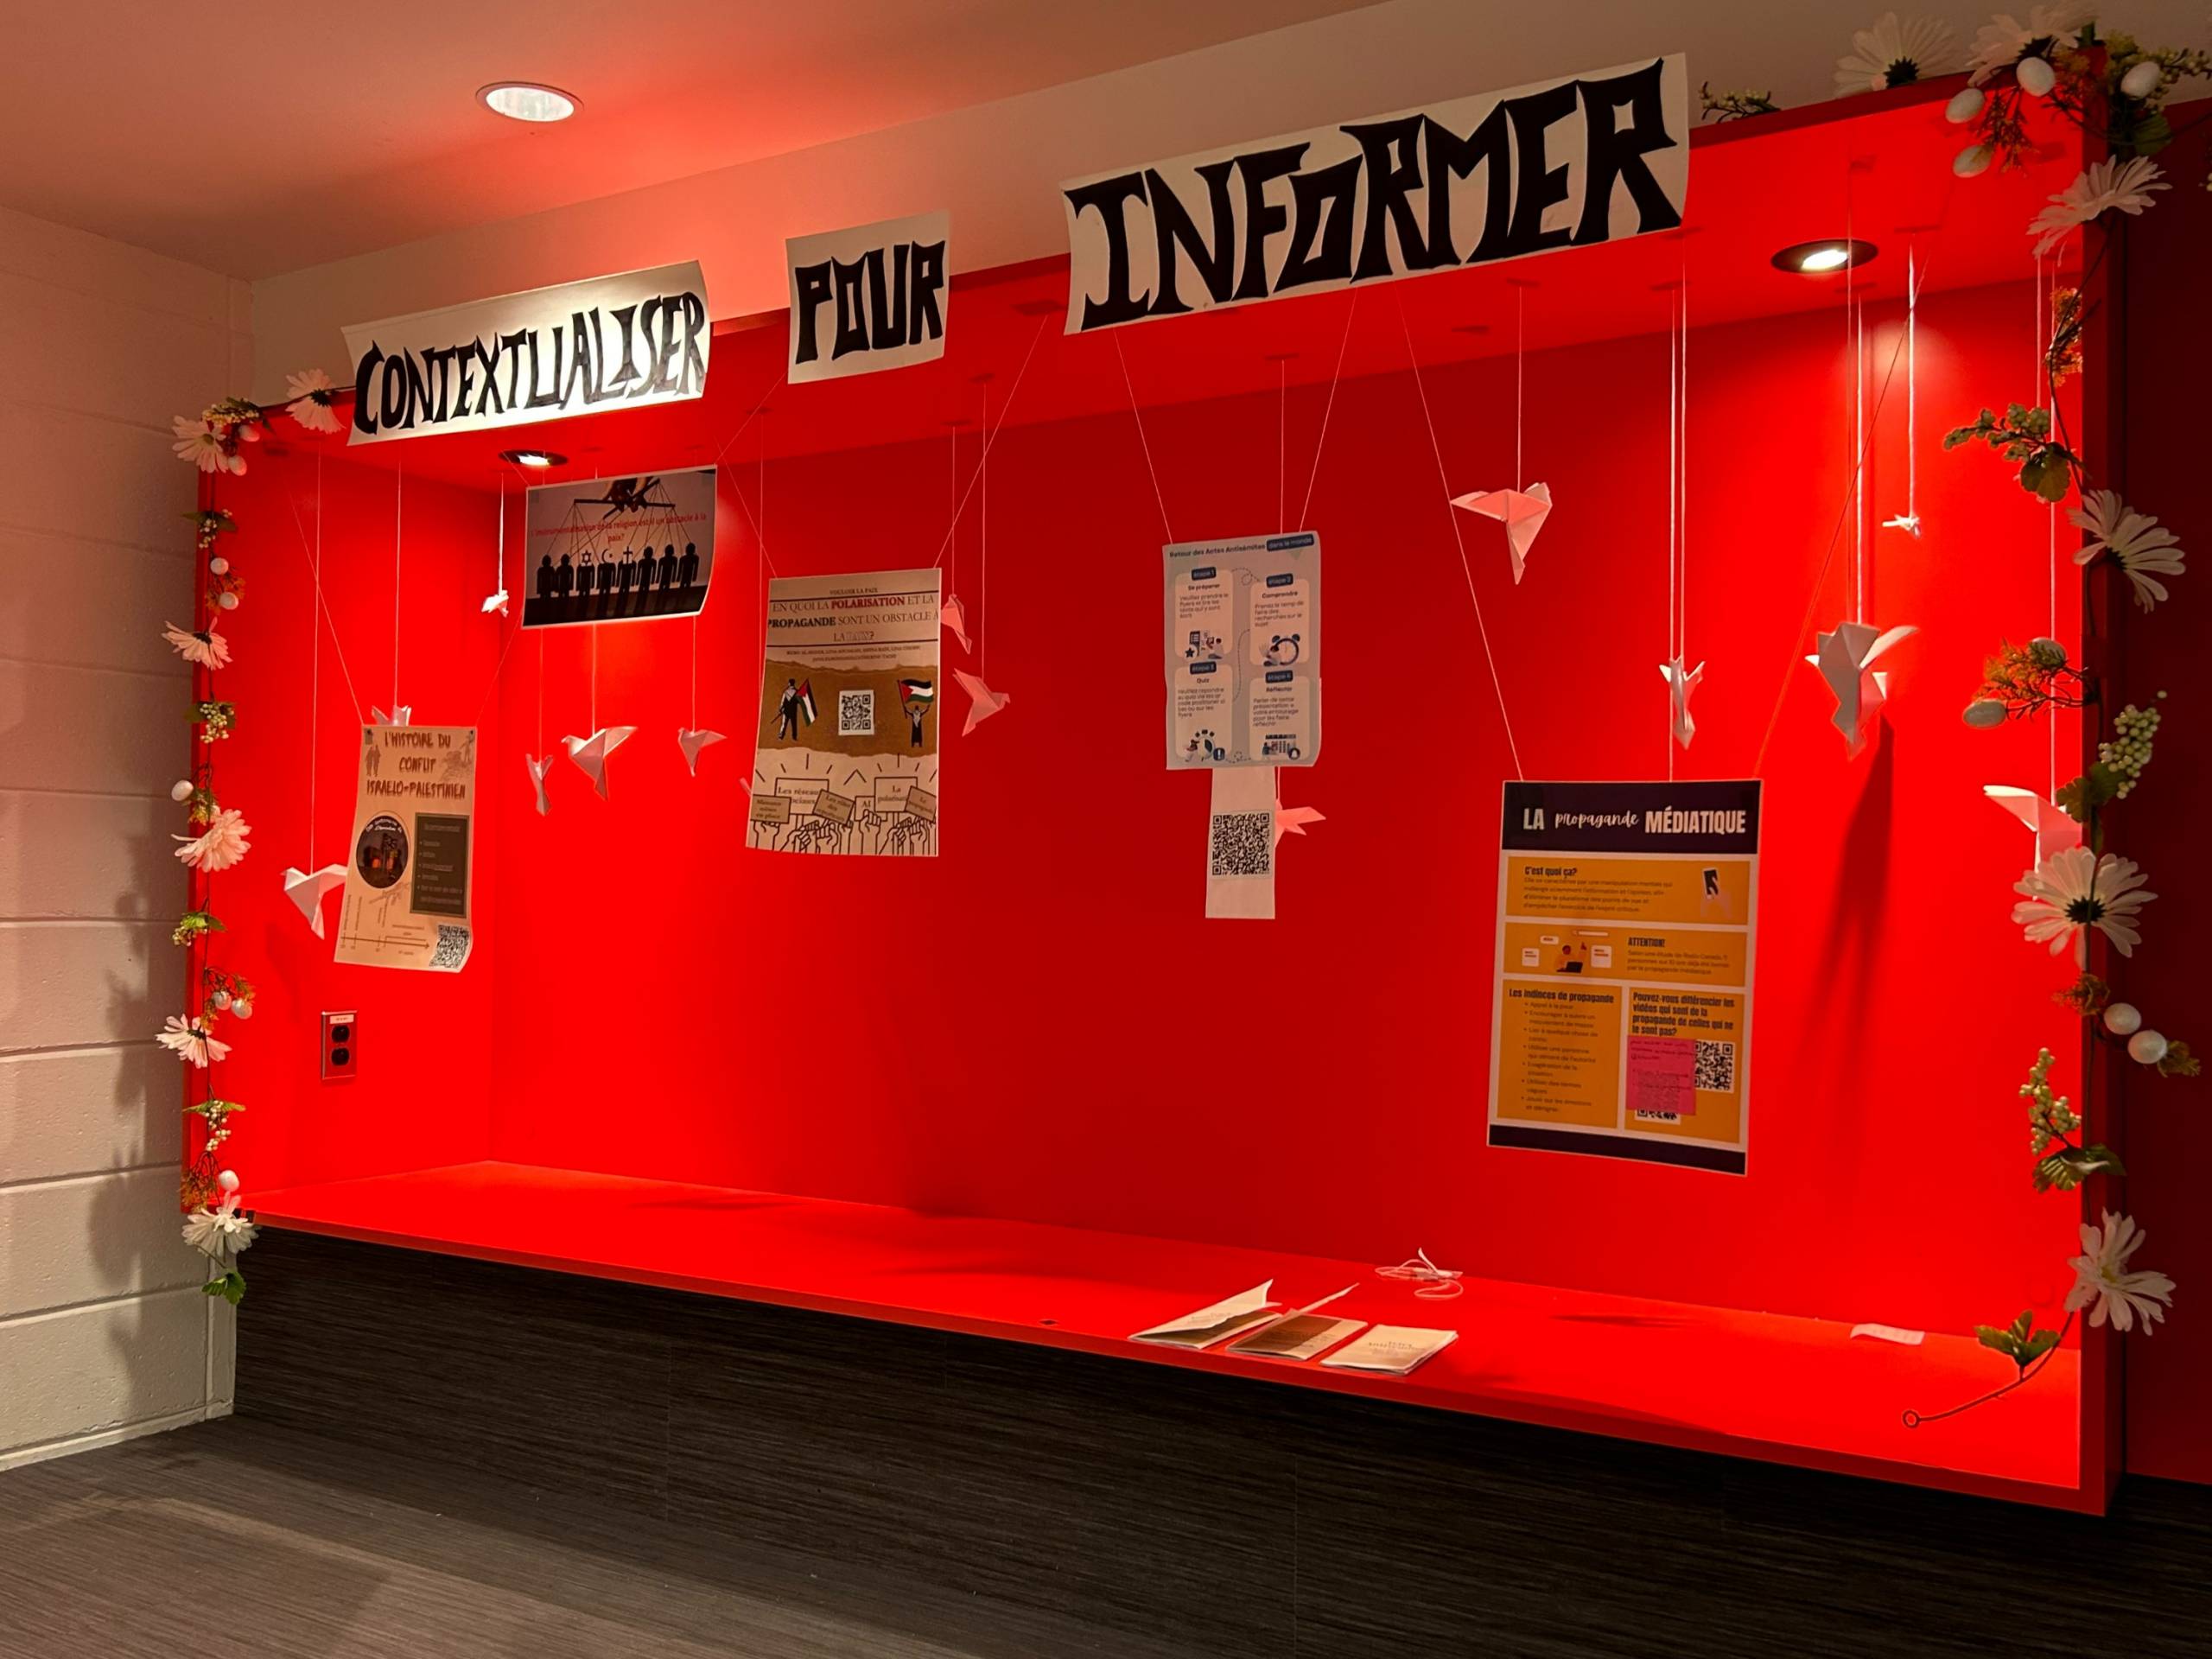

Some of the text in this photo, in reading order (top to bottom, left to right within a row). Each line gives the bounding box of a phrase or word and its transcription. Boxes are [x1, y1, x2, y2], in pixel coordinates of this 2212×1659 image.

[1075, 57, 1682, 314] INFORMER
[794, 239, 946, 364] POUR
[353, 290, 709, 435] CONTEXTUALISER
[773, 594, 934, 613] EN QUOI LA POLARISATION ET LA
[768, 616, 836, 629] PROPAGANDE
[838, 614, 864, 626] SONT
[866, 613, 880, 624] UN
[883, 611, 931, 623] OBSTACLE
[834, 632, 845, 642] LA
[384, 731, 452, 749] L'HISTOIRE DU
[793, 787, 819, 796] réseau
[1522, 805, 1747, 836] LA propagande MÉDIATIQUE
[1524, 866, 1579, 880] C'est quoi ça?
[1627, 936, 1666, 948] ATTENTION!
[1509, 988, 1522, 998] Les
[1558, 991, 1568, 1001] de
[1569, 993, 1615, 1004] propagande
[1633, 991, 1679, 1004] Pouvez-vous
[1723, 997, 1735, 1008] les
[1633, 1002, 1708, 1017] vidéos qui sont de la
[1632, 1014, 1735, 1031] propagande de celles qui ne
[1632, 1025, 1678, 1038] le sont pas?
